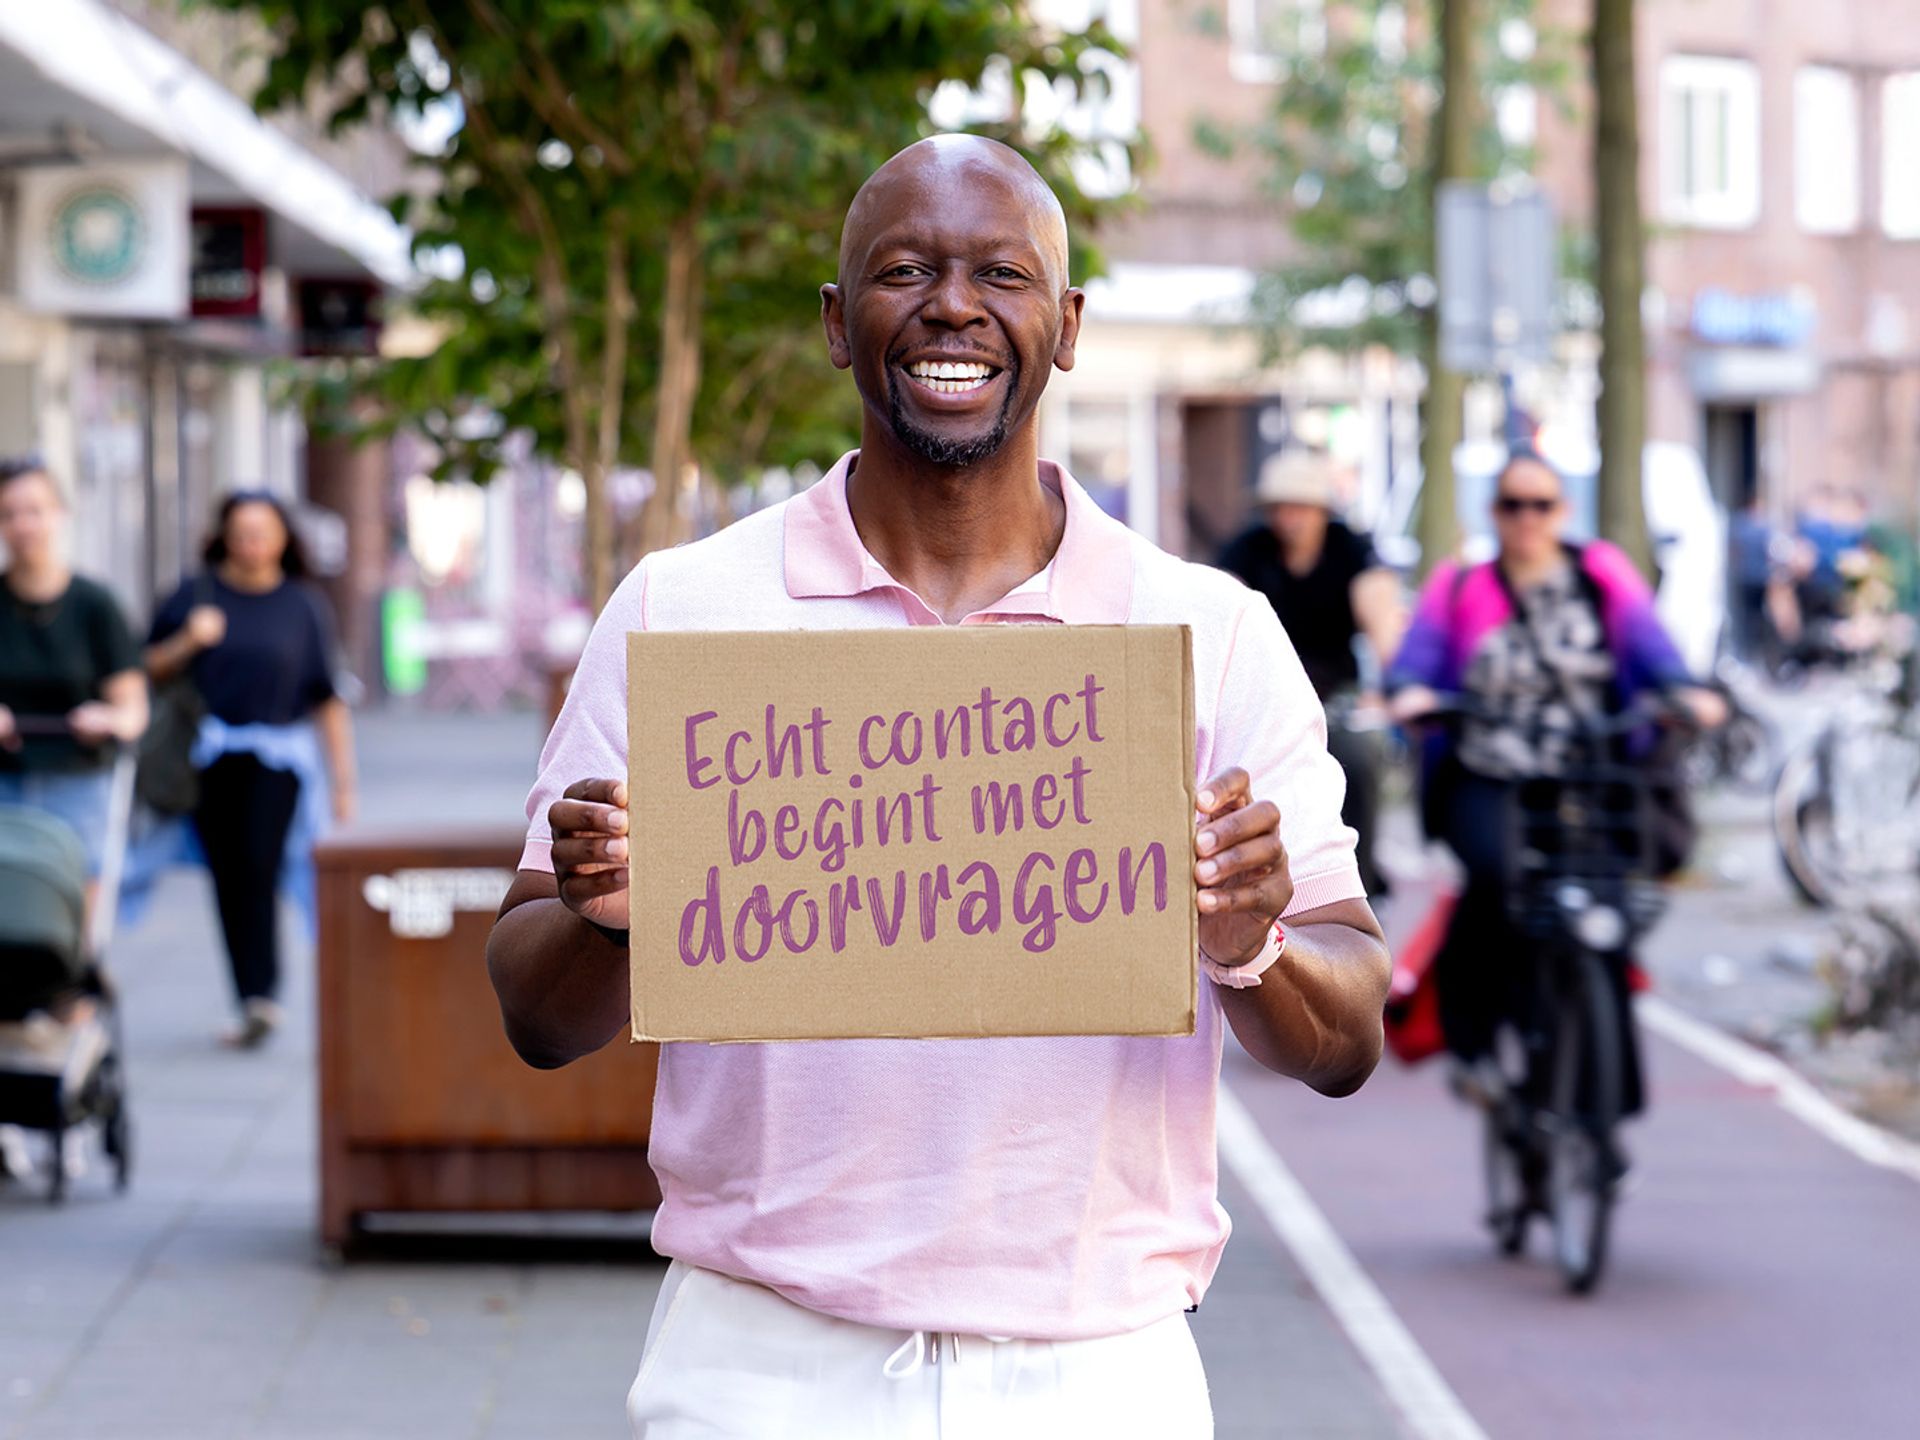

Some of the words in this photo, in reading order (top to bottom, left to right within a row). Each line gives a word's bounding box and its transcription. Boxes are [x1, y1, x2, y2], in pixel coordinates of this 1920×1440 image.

[684, 703, 833, 791] Echt
[857, 674, 1105, 771] contact
[727, 773, 943, 874] begint
[970, 755, 1093, 837] met
[677, 841, 1168, 968] doorvragen
